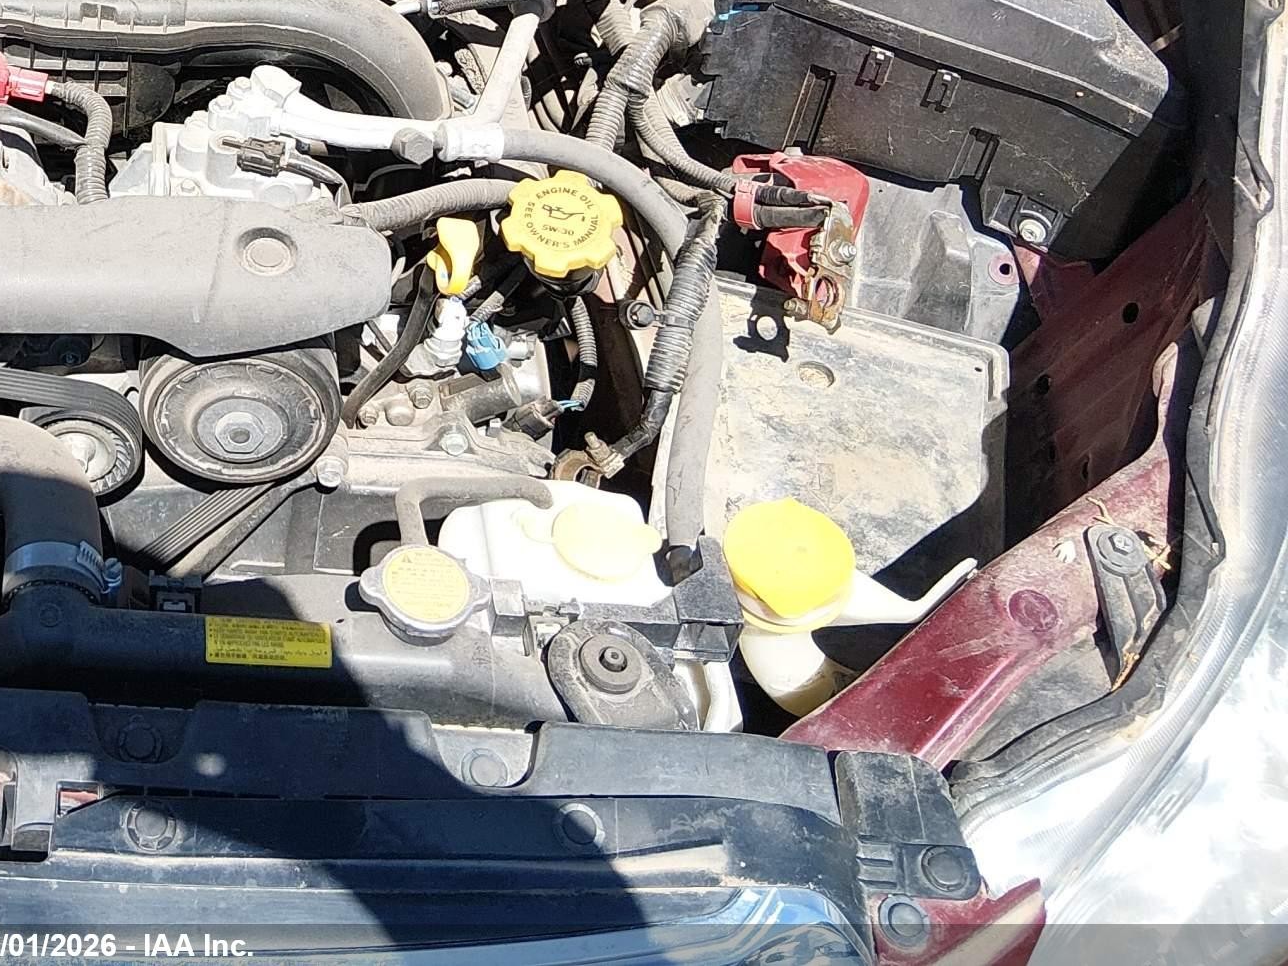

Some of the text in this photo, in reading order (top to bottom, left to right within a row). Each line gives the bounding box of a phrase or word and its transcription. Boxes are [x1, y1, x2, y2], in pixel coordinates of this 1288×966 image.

[536, 187, 596, 210] ENGINE OIL
[524, 202, 599, 248] SEE OWNER'S MANUAL
